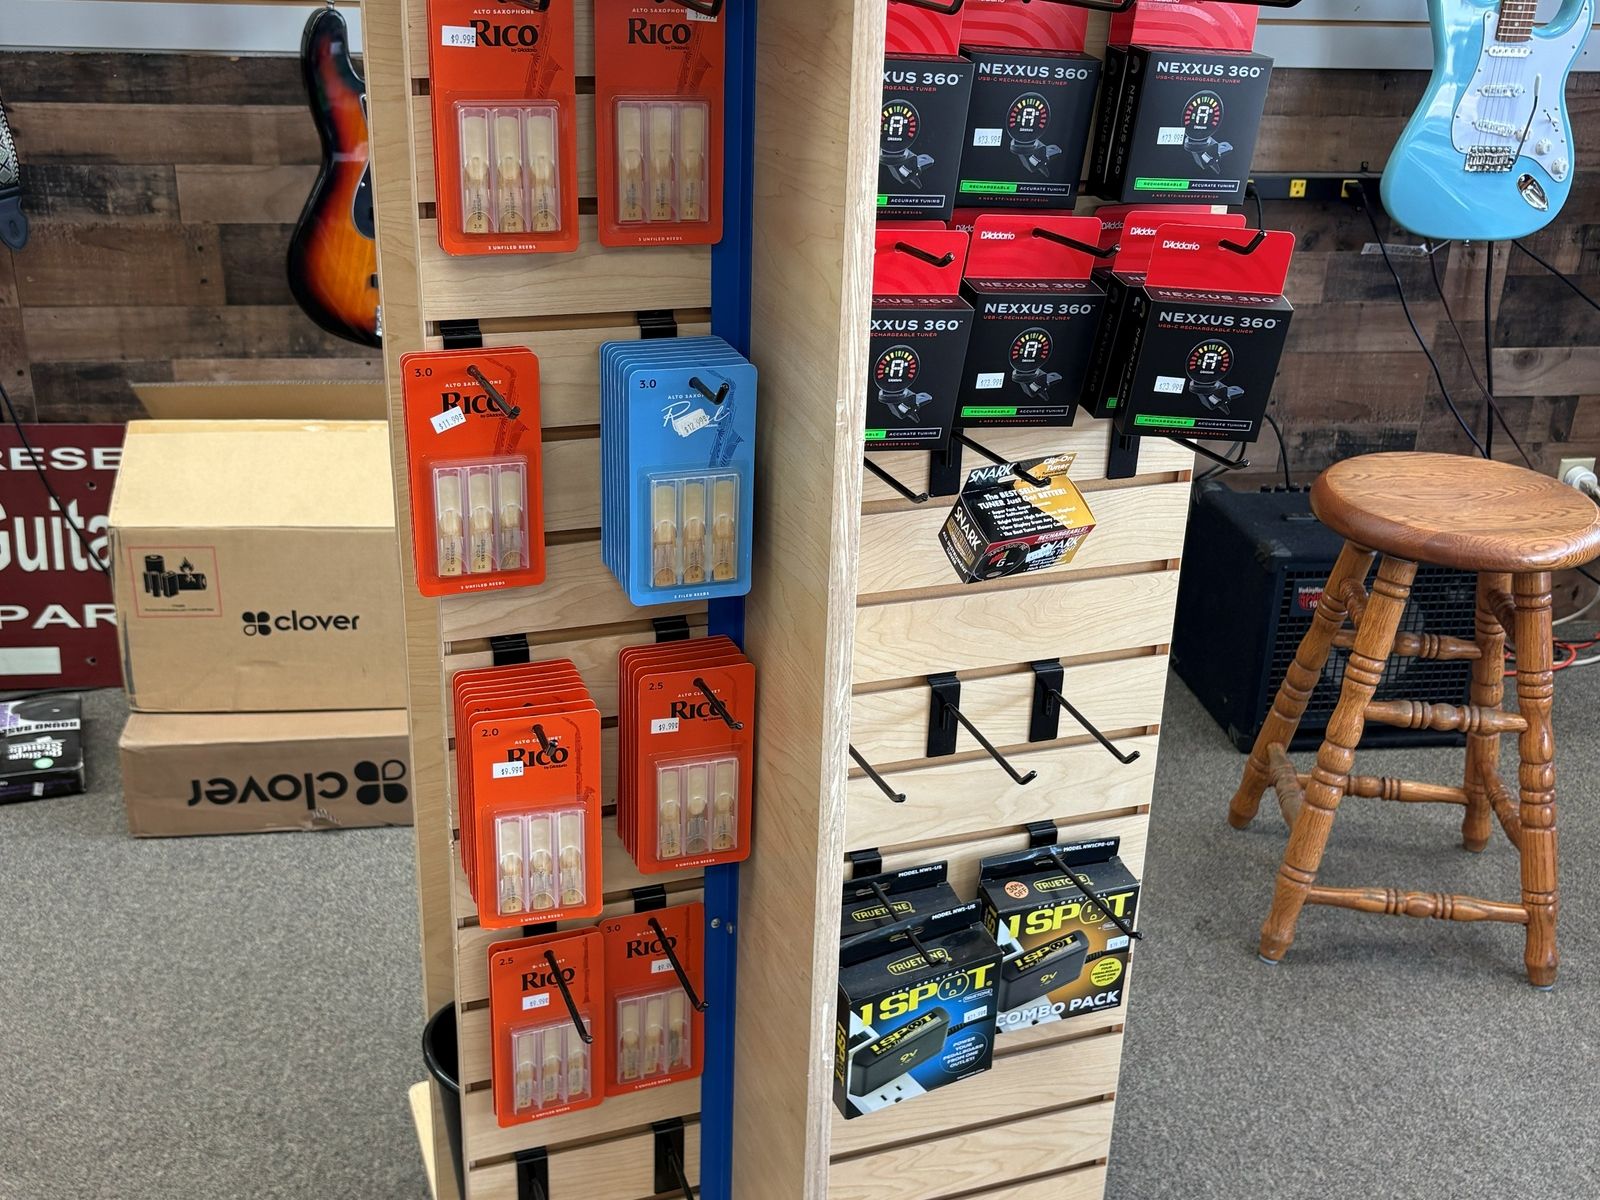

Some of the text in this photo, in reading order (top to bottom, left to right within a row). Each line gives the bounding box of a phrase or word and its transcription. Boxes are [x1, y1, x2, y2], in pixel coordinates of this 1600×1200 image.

[628, 18, 691, 44] RICO
[978, 62, 1088, 80] NEXXUS 360
[1157, 62, 1260, 78] NEXXUS 360
[883, 71, 917, 84] XUS
[980, 231, 1015, 241] D'Addario
[1162, 240, 1200, 250] D'Addario
[985, 304, 1091, 314] NEXXUS 360
[871, 320, 959, 330] XXUS 360
[1160, 312, 1276, 329] NEXXUS 360
[415, 368, 432, 377] 3.0
[640, 379, 656, 388] 3.0
[968, 462, 1018, 483] SNARK
[1046, 463, 1069, 471] Tuner
[978, 500, 1005, 510] TUNER
[1007, 497, 1021, 505] Just
[984, 493, 999, 501] The
[954, 507, 982, 551] SNARK
[274, 610, 359, 632] clover
[482, 728, 498, 737] 2.0
[187, 771, 348, 810] clover
[1036, 876, 1086, 890] TRUETOE
[855, 903, 910, 919] TRUETNE
[932, 911, 952, 920] MODEL
[606, 925, 621, 933] 3.0
[1009, 915, 1021, 938] 1
[890, 950, 945, 973] TRUETNE
[1040, 971, 1058, 983] 9V
[860, 962, 996, 1026] 1 SPOT
[996, 990, 1120, 1026] COMBO PACK
[953, 1037, 975, 1047] POWER
[955, 1042, 972, 1051] YOUR
[900, 1049, 918, 1062] 9V
[943, 1043, 984, 1060] PEDALBOARD
[947, 1055, 964, 1064] FROM
